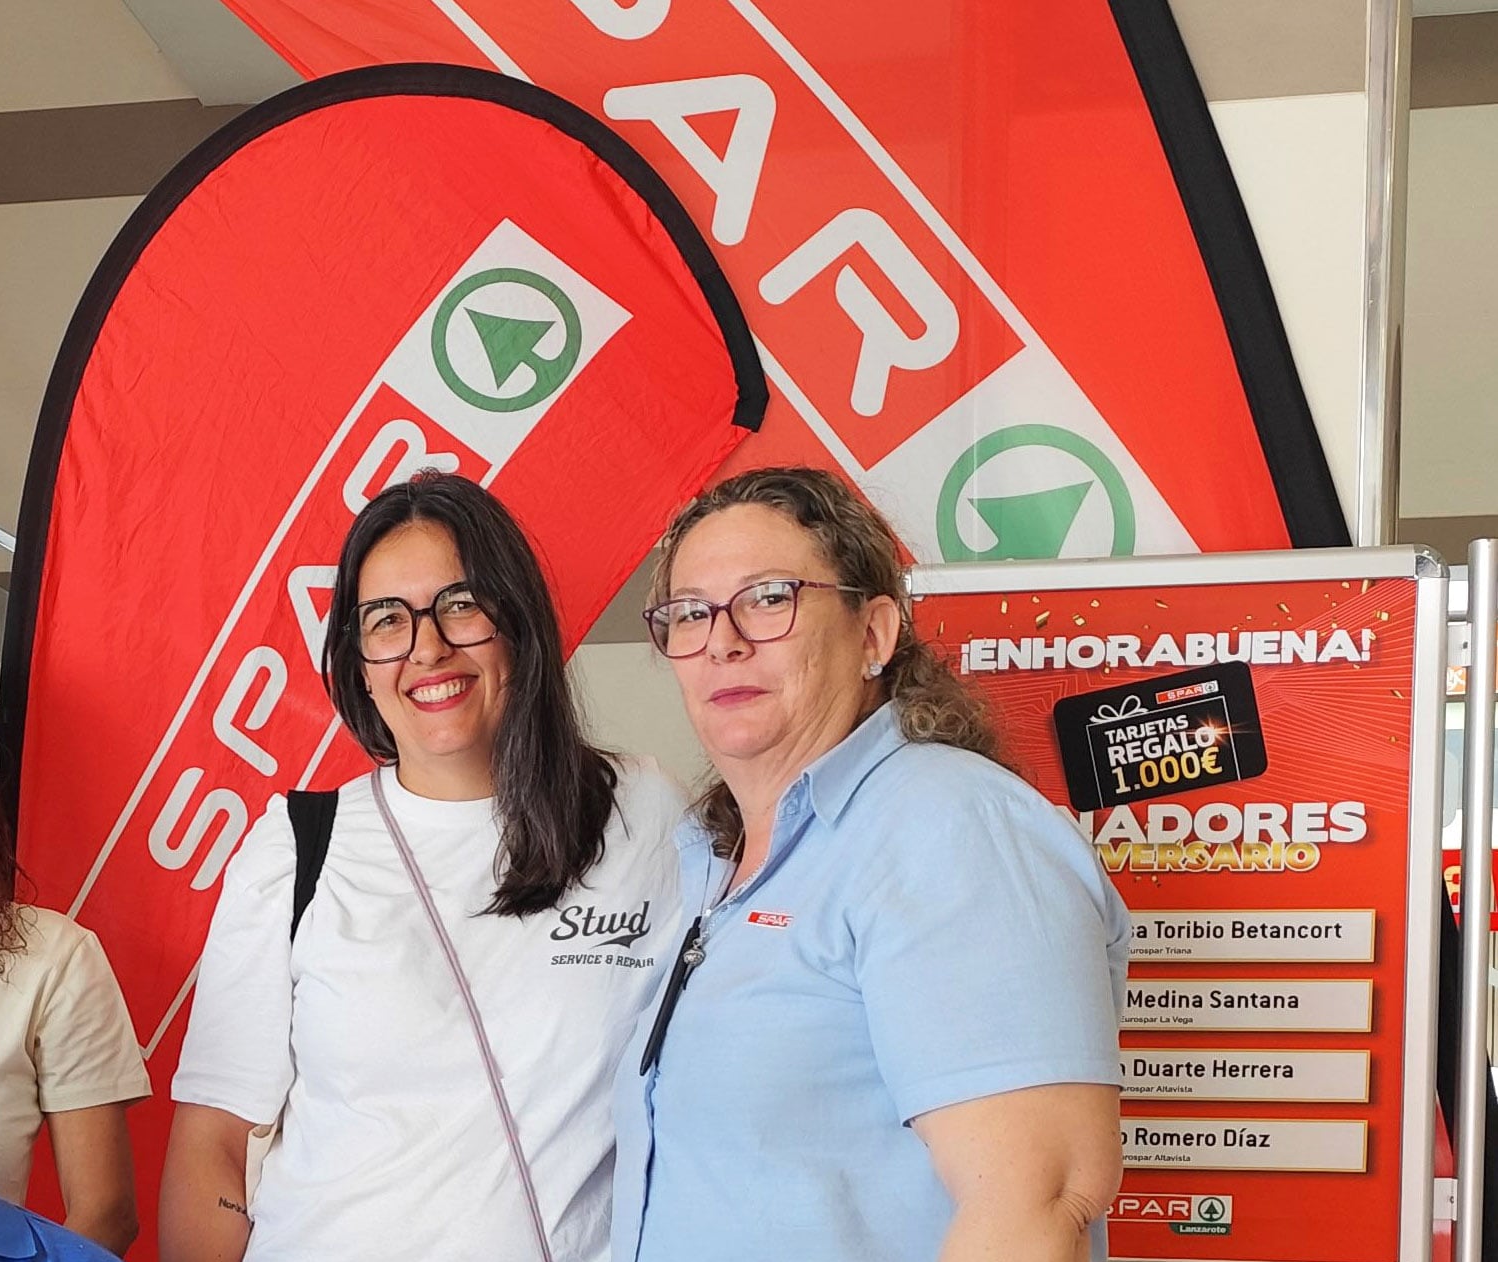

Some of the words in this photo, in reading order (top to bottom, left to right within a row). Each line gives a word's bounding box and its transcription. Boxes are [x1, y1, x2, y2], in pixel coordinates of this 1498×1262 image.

[960, 629, 1372, 675] ¡ENHORABUENA!
[1167, 686, 1203, 700] SPAR
[1104, 714, 1189, 745] TARJETAS
[1107, 726, 1216, 767] REGALO
[1112, 746, 1222, 794] 1.000€
[1055, 801, 1367, 844] NADORES
[1097, 842, 1320, 872] VERSARIO
[550, 900, 651, 942] Stwd
[1154, 920, 1224, 939] Toribio
[1231, 920, 1343, 939] Betancort
[1165, 946, 1192, 954] Triana
[551, 954, 602, 966] SERVICE
[615, 956, 654, 968] REPAIR
[1126, 990, 1203, 1008] Medina
[1209, 990, 1299, 1009] Santana
[1160, 1015, 1170, 1023] La
[1172, 1015, 1193, 1024] Vega
[1133, 1059, 1206, 1078] Duarte
[1212, 1059, 1294, 1079] Herrera
[1156, 1085, 1192, 1093] Altavista
[1135, 1127, 1216, 1147] Romero
[1223, 1127, 1271, 1148] Díaz
[1123, 1154, 1152, 1162] rospar
[1154, 1154, 1191, 1162] Altavista
[1179, 1224, 1227, 1234] Lanzarote
